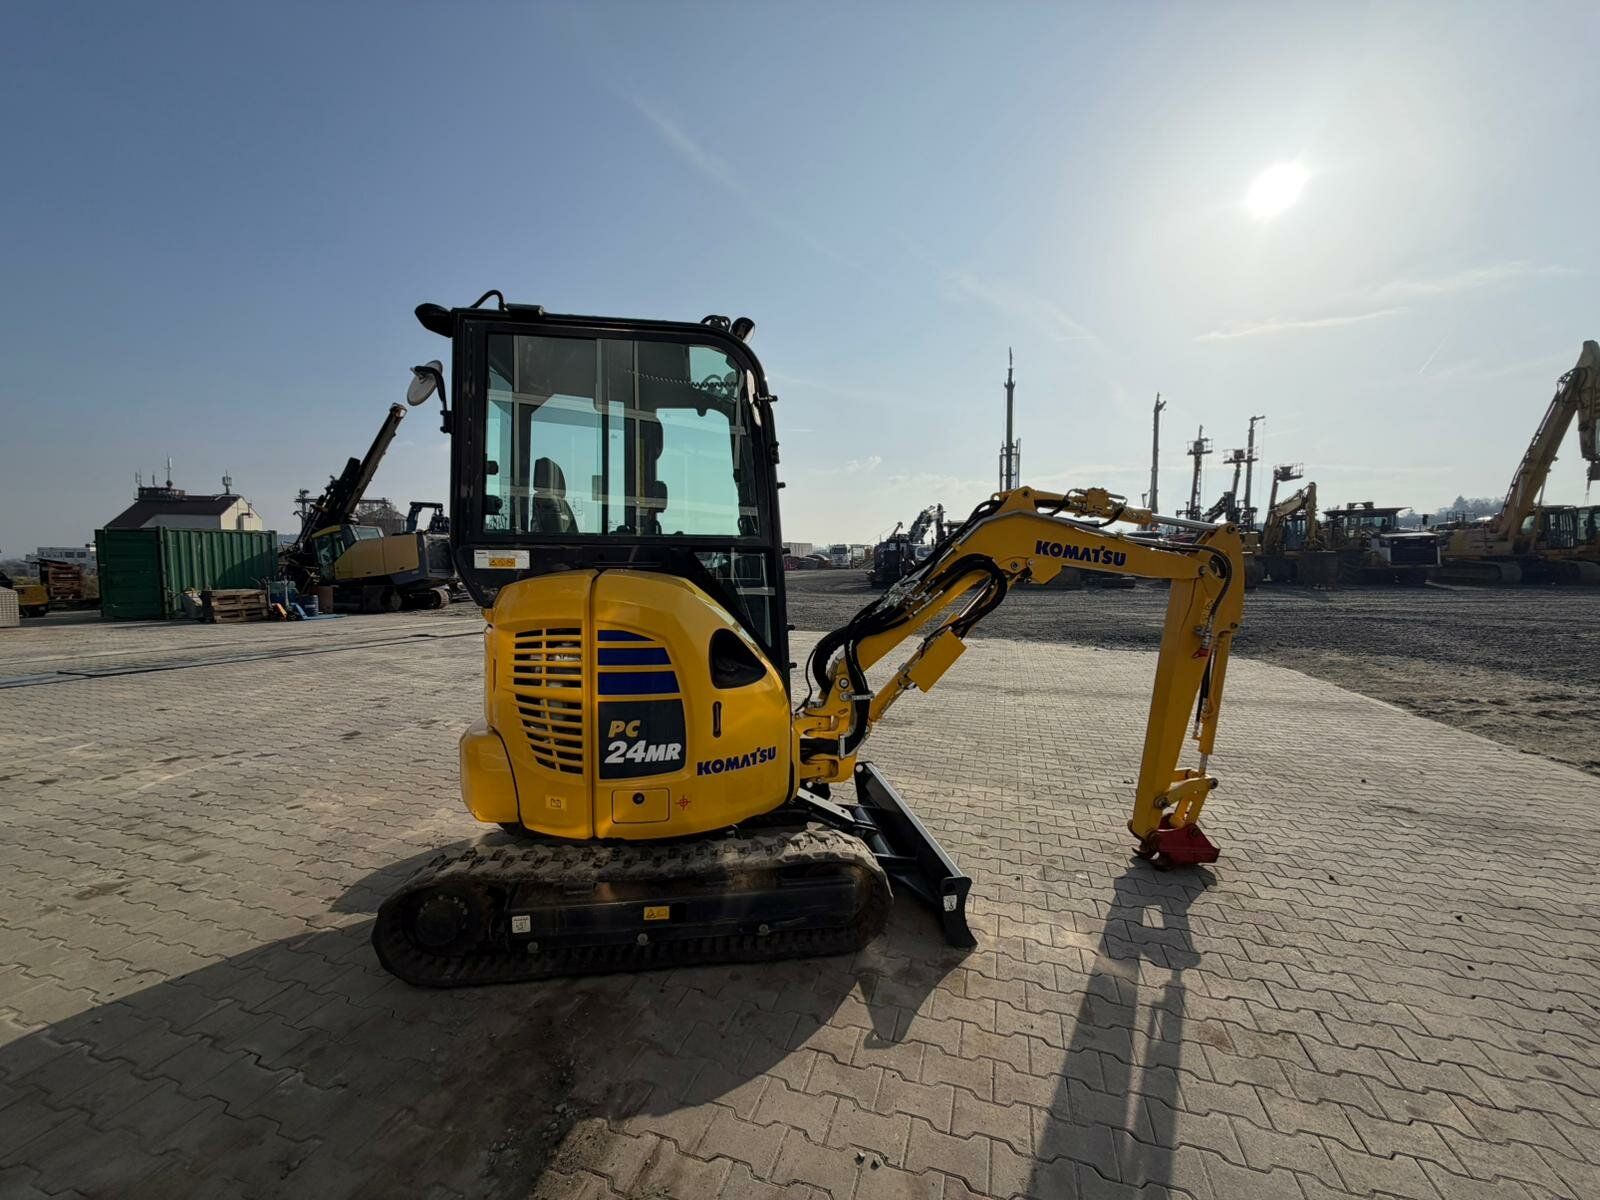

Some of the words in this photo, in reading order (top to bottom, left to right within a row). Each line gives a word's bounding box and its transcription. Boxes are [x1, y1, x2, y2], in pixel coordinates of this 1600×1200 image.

[1035, 540, 1127, 566] KOMATSU
[608, 720, 641, 738] PC
[604, 740, 682, 764] 24MR
[696, 746, 777, 776] KOMATSU
